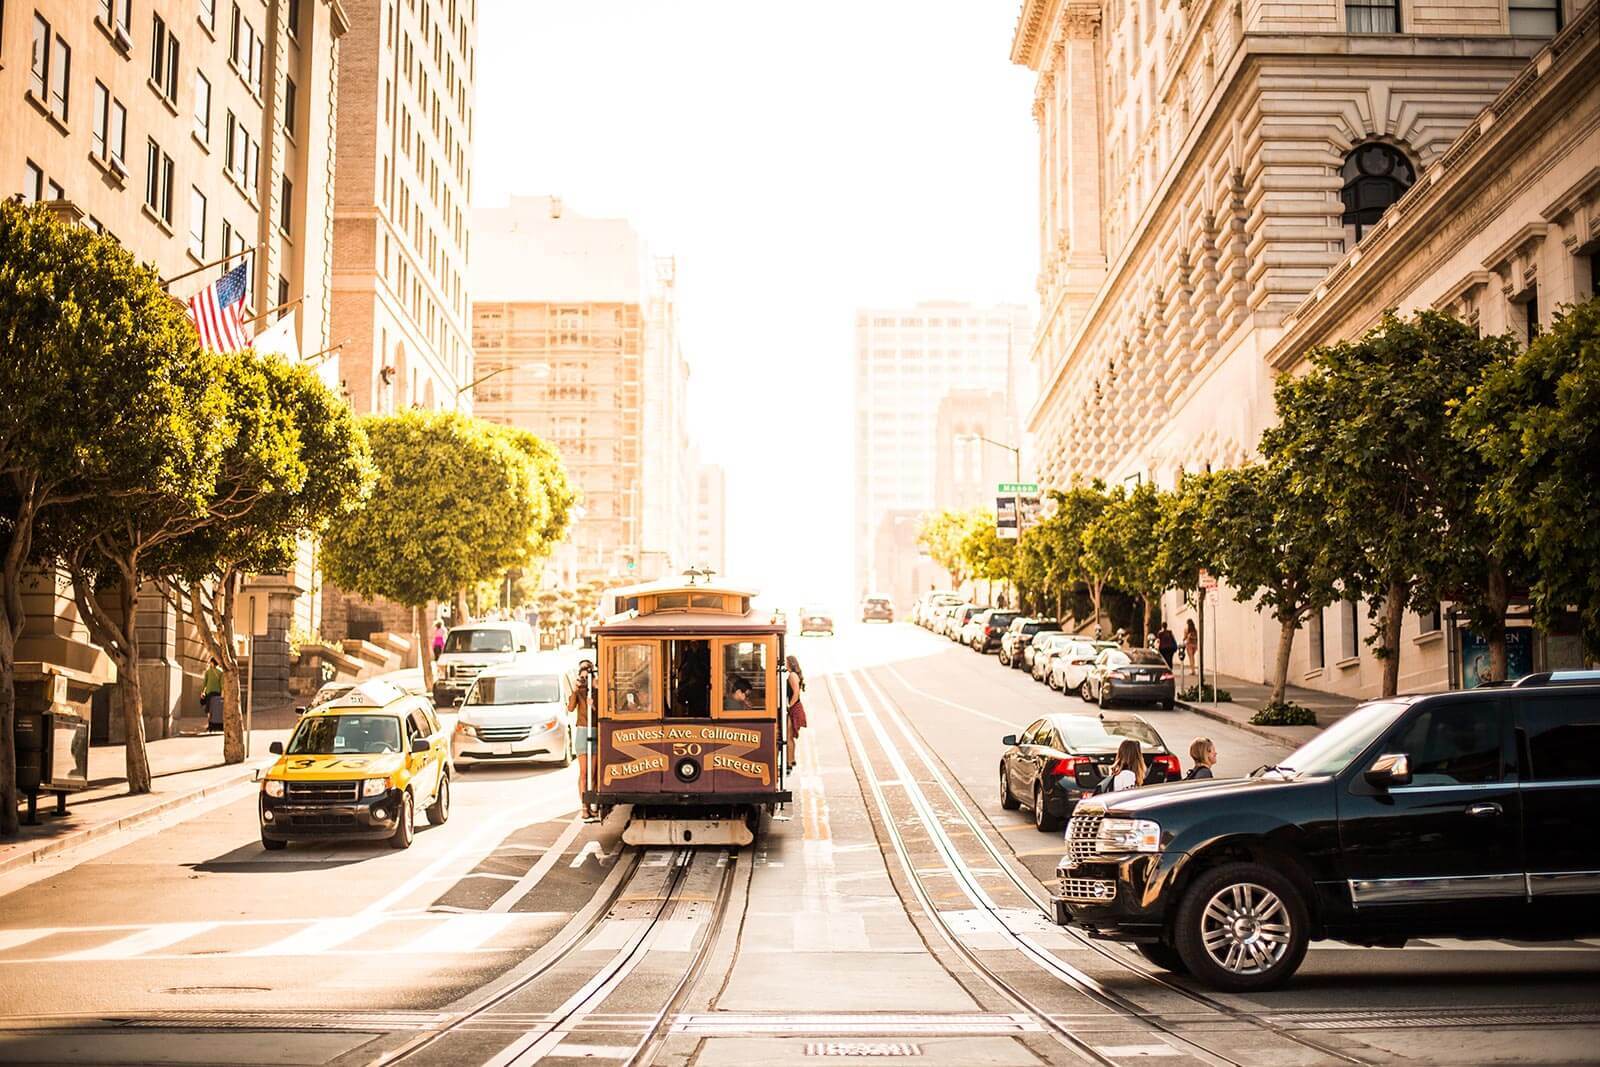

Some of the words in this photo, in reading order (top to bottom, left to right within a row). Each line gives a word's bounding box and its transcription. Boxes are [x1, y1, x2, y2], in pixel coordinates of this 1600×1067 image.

[615, 731, 636, 742] Van
[636, 729, 665, 740] Ness
[701, 727, 759, 743] California
[672, 742, 702, 756] 50
[610, 767, 619, 776] &
[622, 757, 664, 775] Market
[713, 755, 762, 774] Streets
